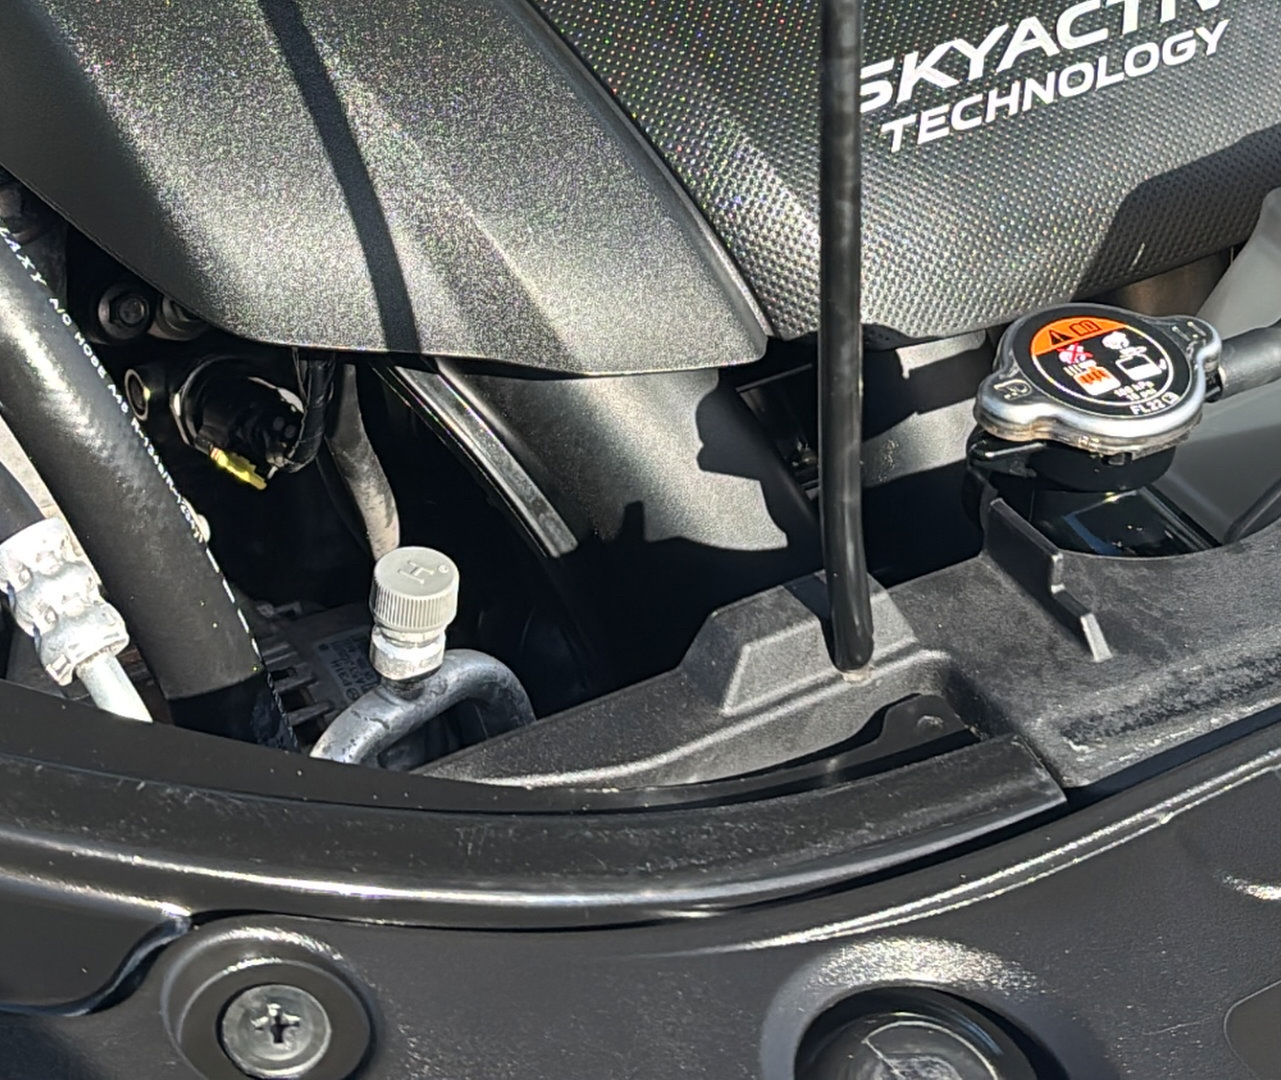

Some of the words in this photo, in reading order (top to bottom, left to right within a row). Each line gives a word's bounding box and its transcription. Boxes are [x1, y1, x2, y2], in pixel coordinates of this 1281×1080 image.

[880, 19, 1230, 153] TECHNOLOGY
[49, 298, 72, 326] A/C
[74, 331, 108, 379] HOSE
[1130, 399, 1166, 415] FL22
